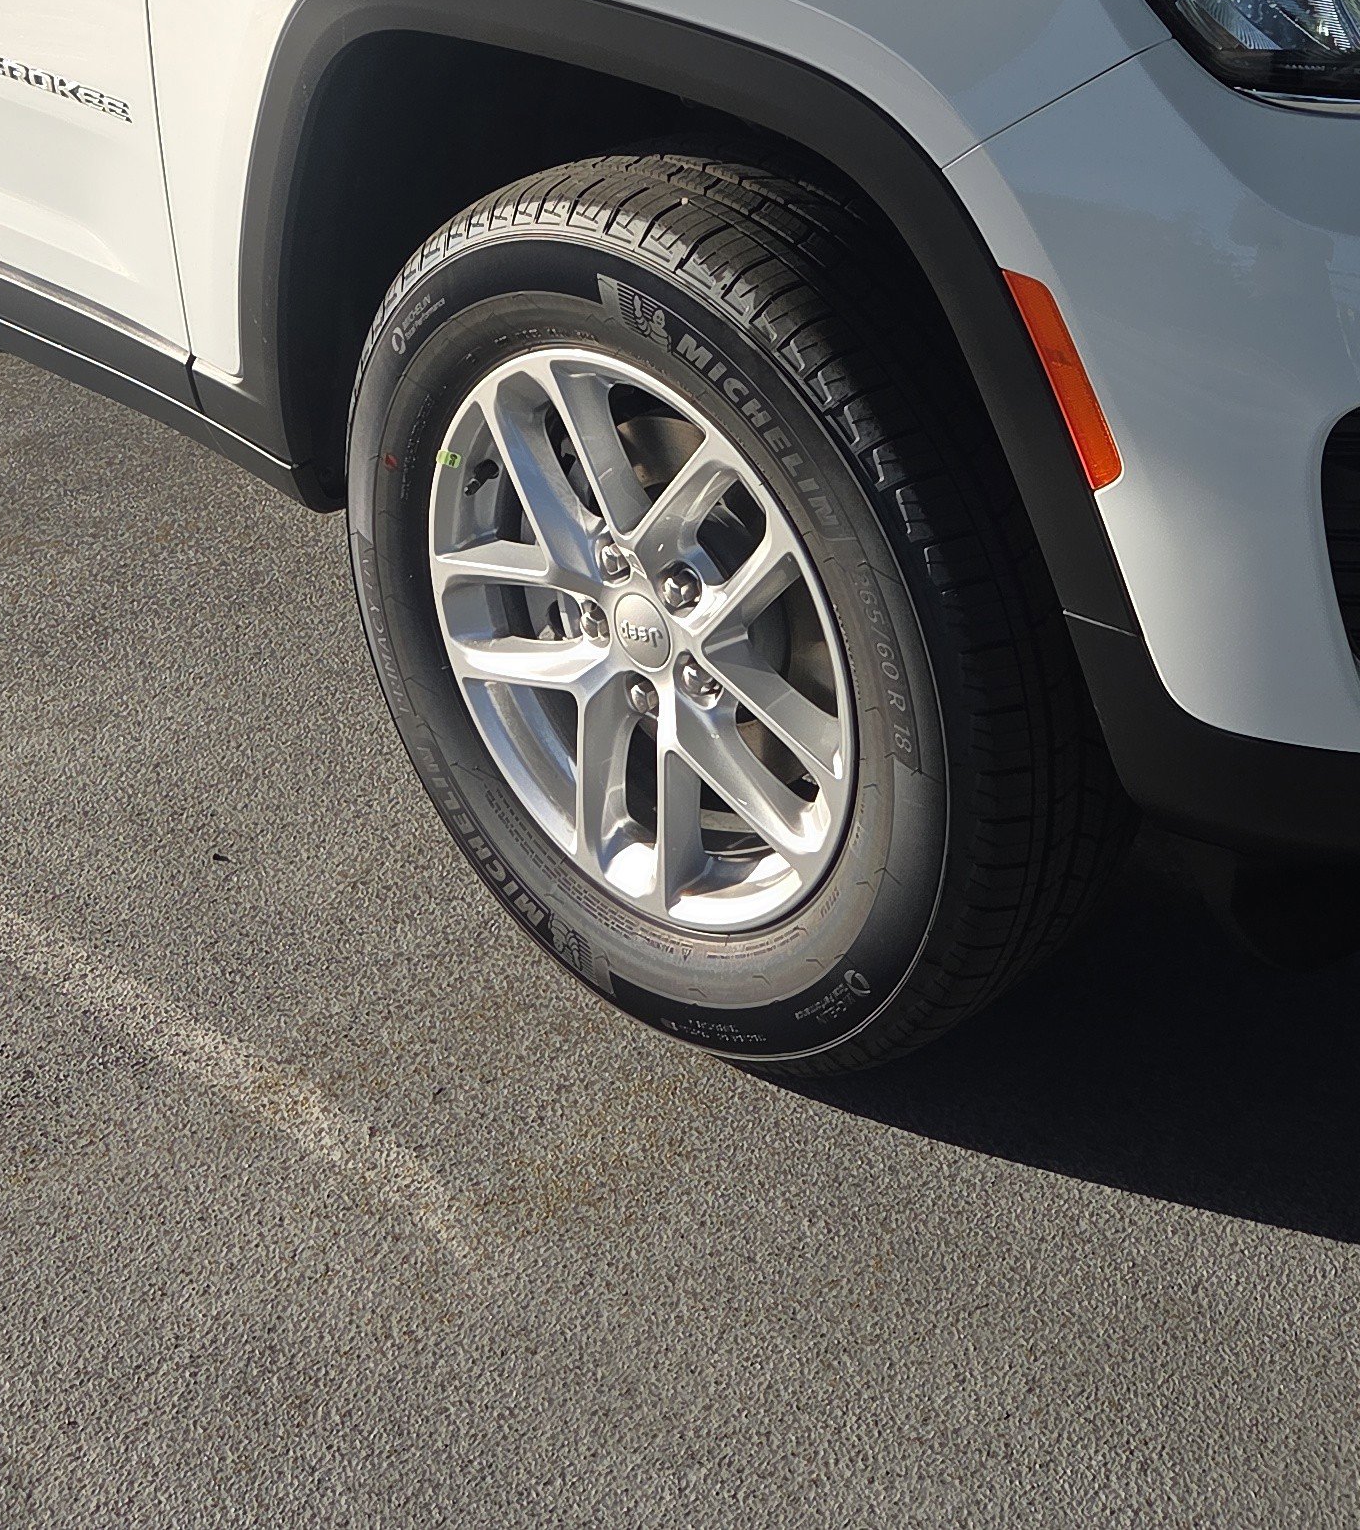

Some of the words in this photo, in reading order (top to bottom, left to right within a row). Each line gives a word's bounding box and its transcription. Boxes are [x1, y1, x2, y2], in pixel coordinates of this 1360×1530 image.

[676, 333, 840, 527] MICHELIN
[887, 689, 906, 713] R
[893, 722, 913, 754] 18
[416, 745, 546, 928] MICHELIN
